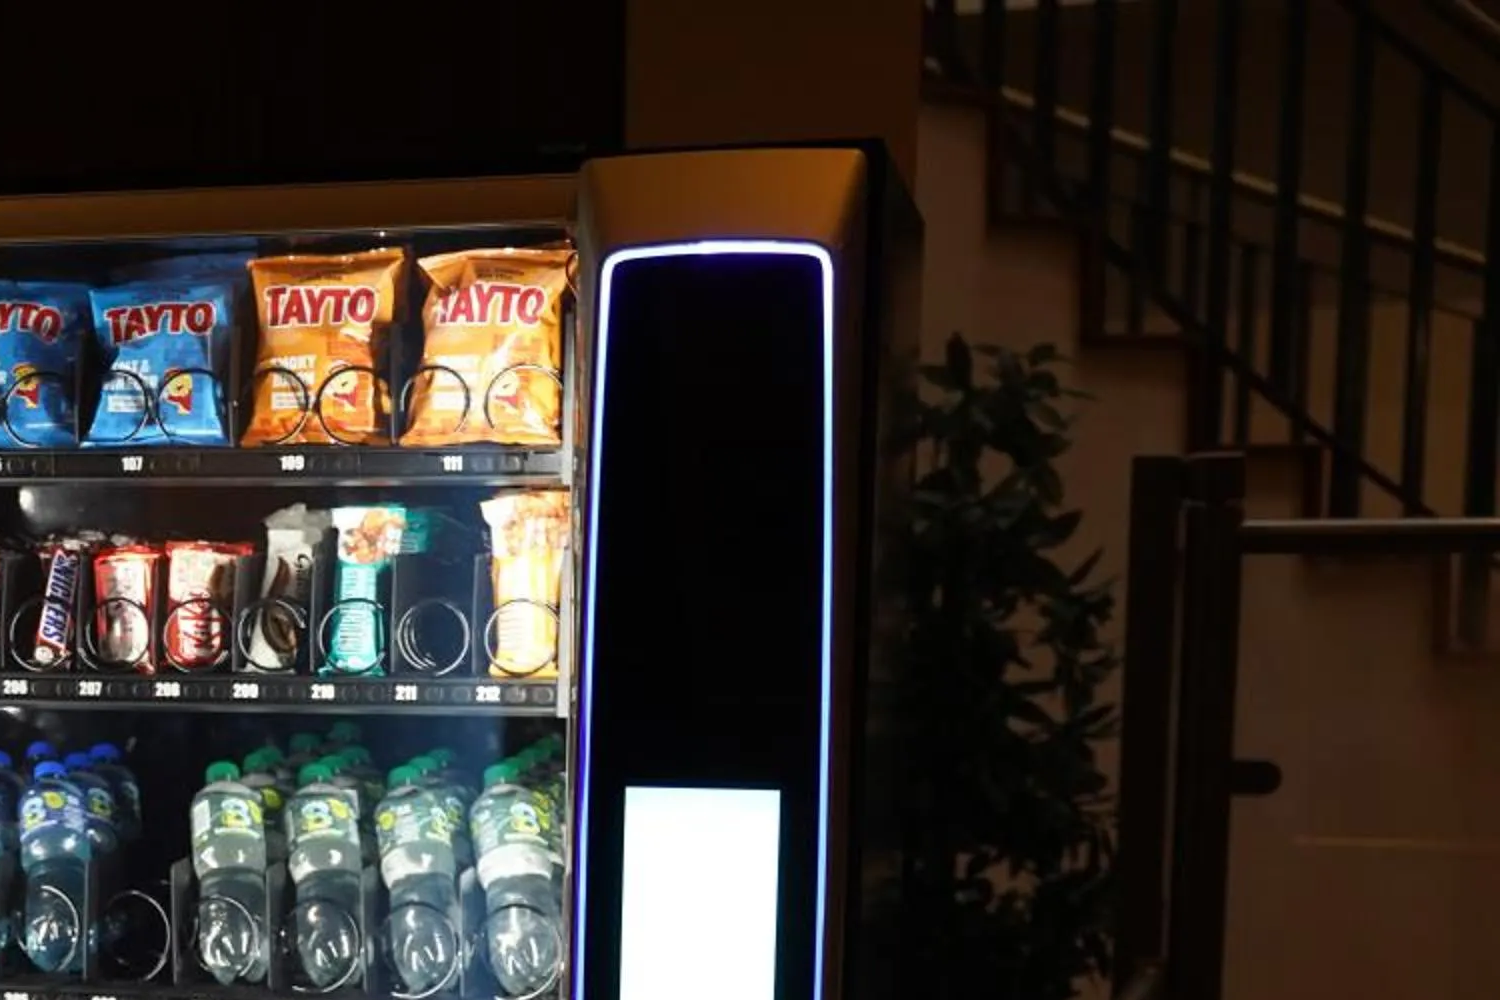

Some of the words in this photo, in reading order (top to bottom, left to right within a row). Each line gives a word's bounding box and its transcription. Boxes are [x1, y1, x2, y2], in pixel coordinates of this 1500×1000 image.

[106, 301, 215, 345] TAYTO
[266, 285, 376, 327] TAYTO
[437, 280, 545, 325] TAYTO
[79, 681, 102, 695] 207
